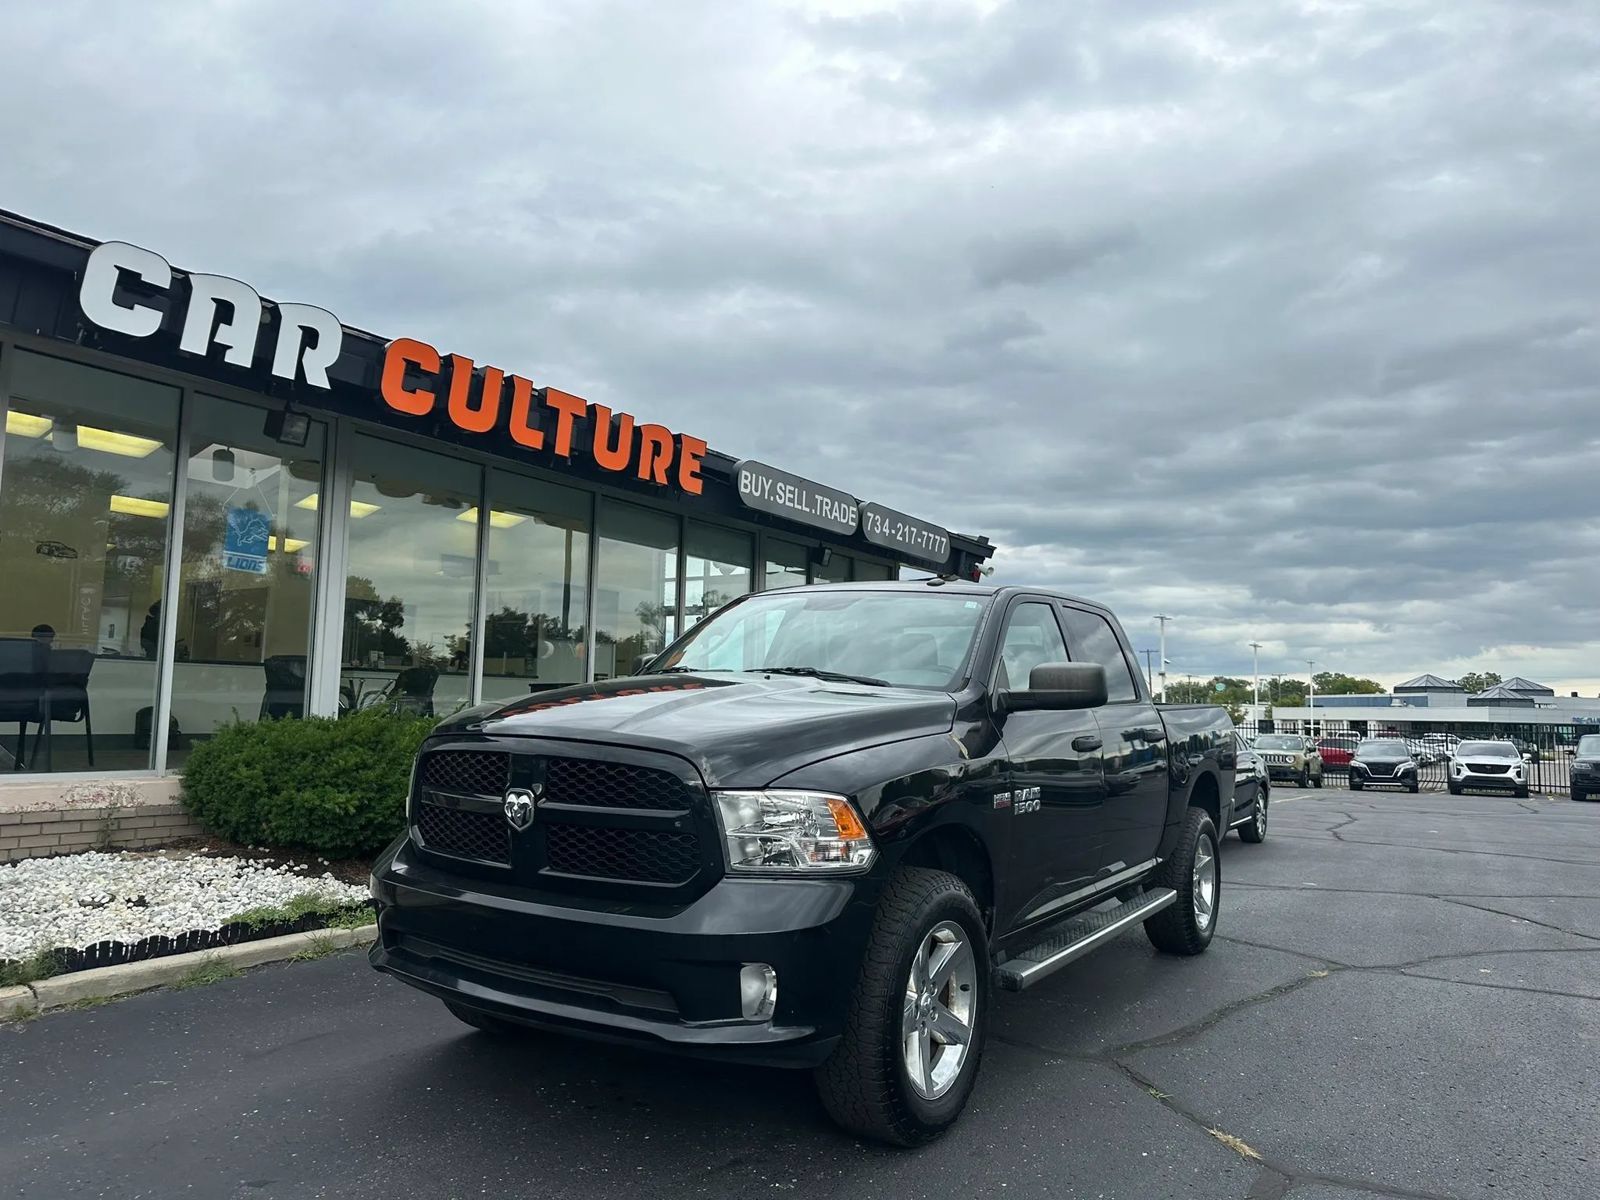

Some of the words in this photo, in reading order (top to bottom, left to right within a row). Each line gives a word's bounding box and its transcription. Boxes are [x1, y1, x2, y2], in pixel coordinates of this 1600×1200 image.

[79, 240, 342, 390] CAR
[380, 338, 707, 495] CULTURE
[866, 511, 947, 554] 734-217-7777
[1014, 799, 1041, 815] 1500
